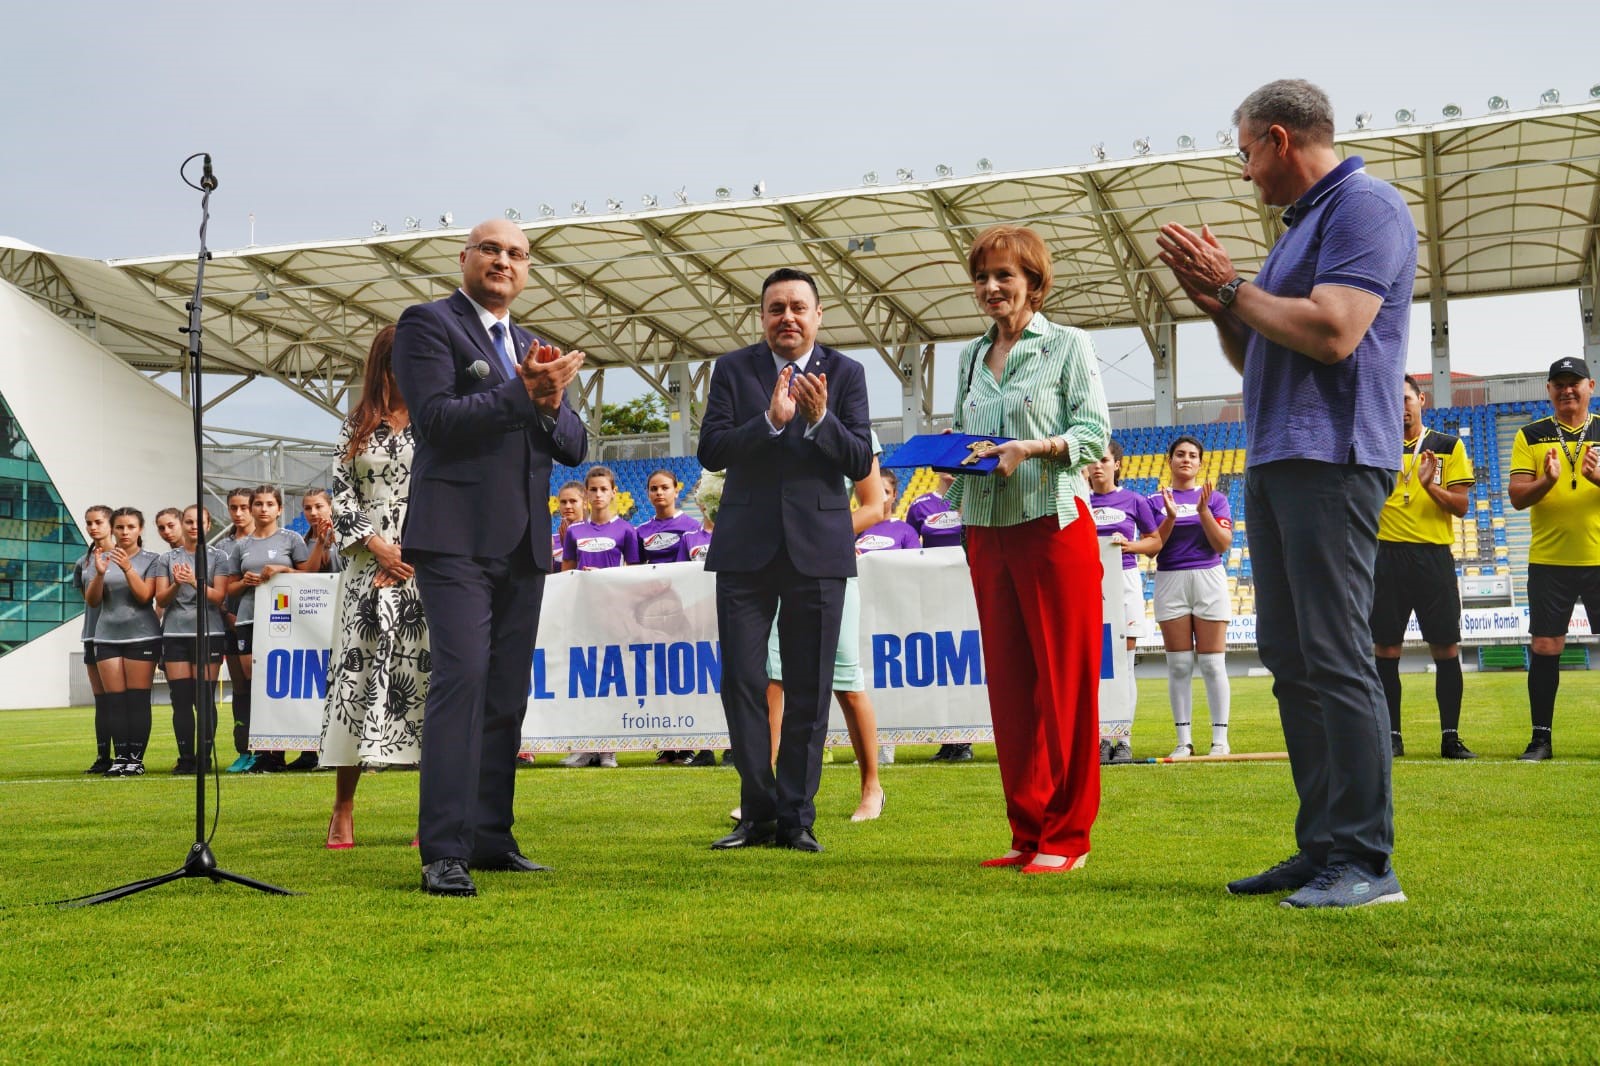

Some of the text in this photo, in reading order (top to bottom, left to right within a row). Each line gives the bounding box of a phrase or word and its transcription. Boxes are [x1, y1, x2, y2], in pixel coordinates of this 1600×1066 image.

[1242, 617, 1256, 627] OL
[1465, 614, 1491, 634] Sportiv
[1568, 619, 1588, 628] ATIA
[1226, 631, 1256, 640] TIV RO
[266, 649, 329, 699] OIN
[568, 641, 723, 708] NAȚION
[622, 712, 695, 729] froina.ro
